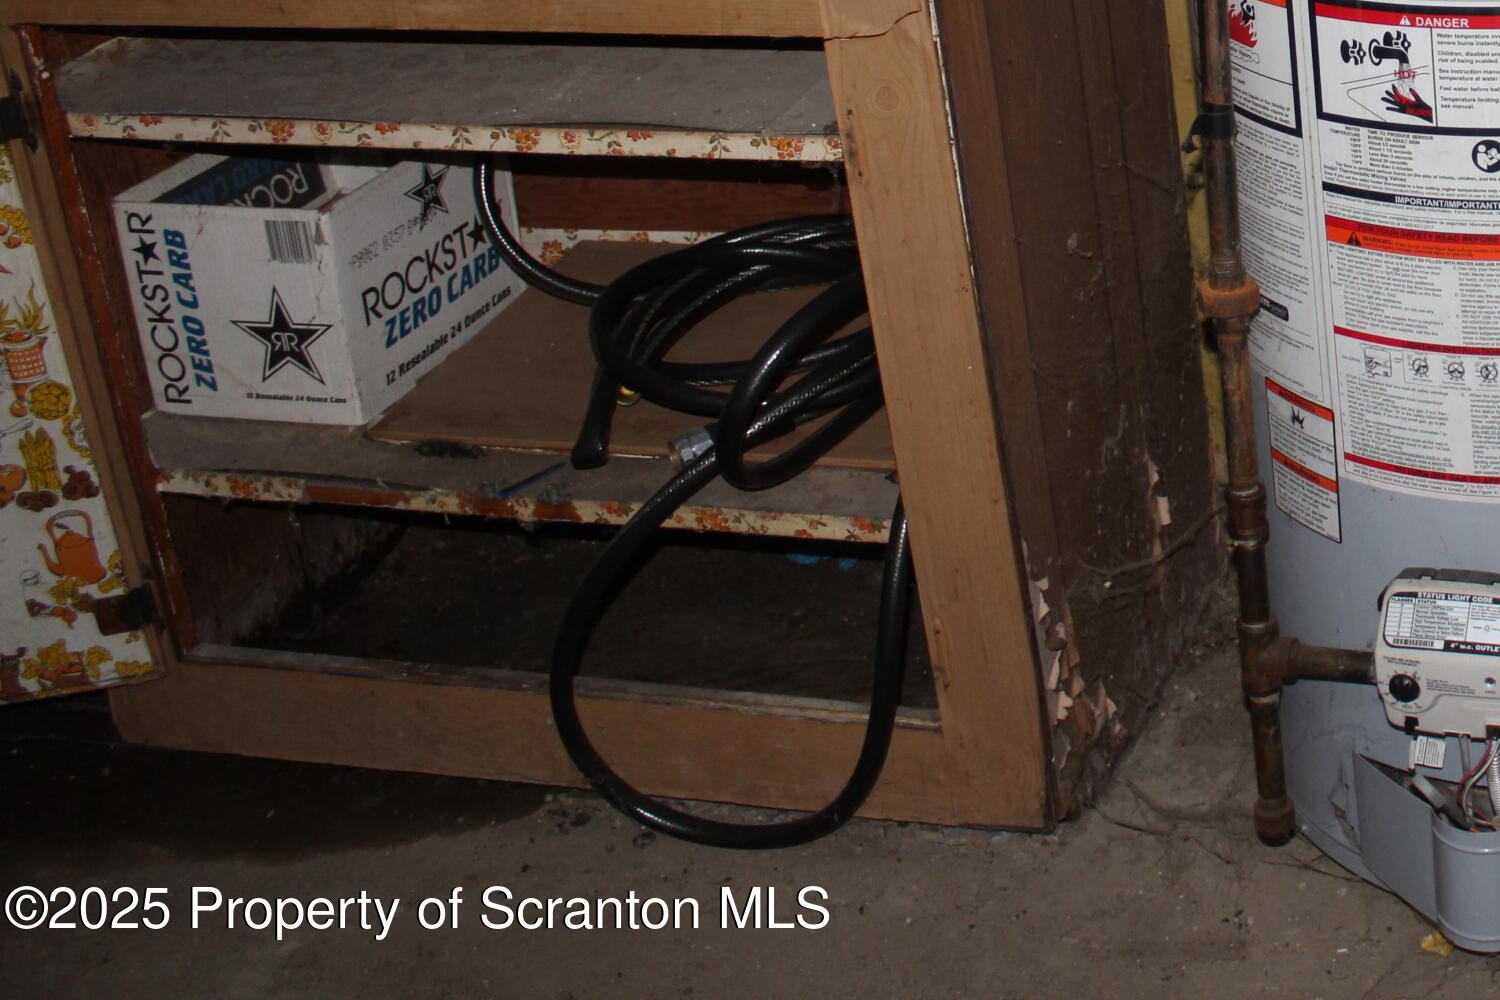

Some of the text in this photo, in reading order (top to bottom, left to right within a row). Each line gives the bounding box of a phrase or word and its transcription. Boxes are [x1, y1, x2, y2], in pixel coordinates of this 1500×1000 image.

[1415, 16, 1469, 29] DANGER
[163, 228, 218, 392] ZERO CARB
[385, 246, 501, 349] ZERO CARB
[386, 286, 512, 386] 12 Resealable 24 Ounce Cans
[1417, 592, 1493, 604] STATUS LIGHT CODE
